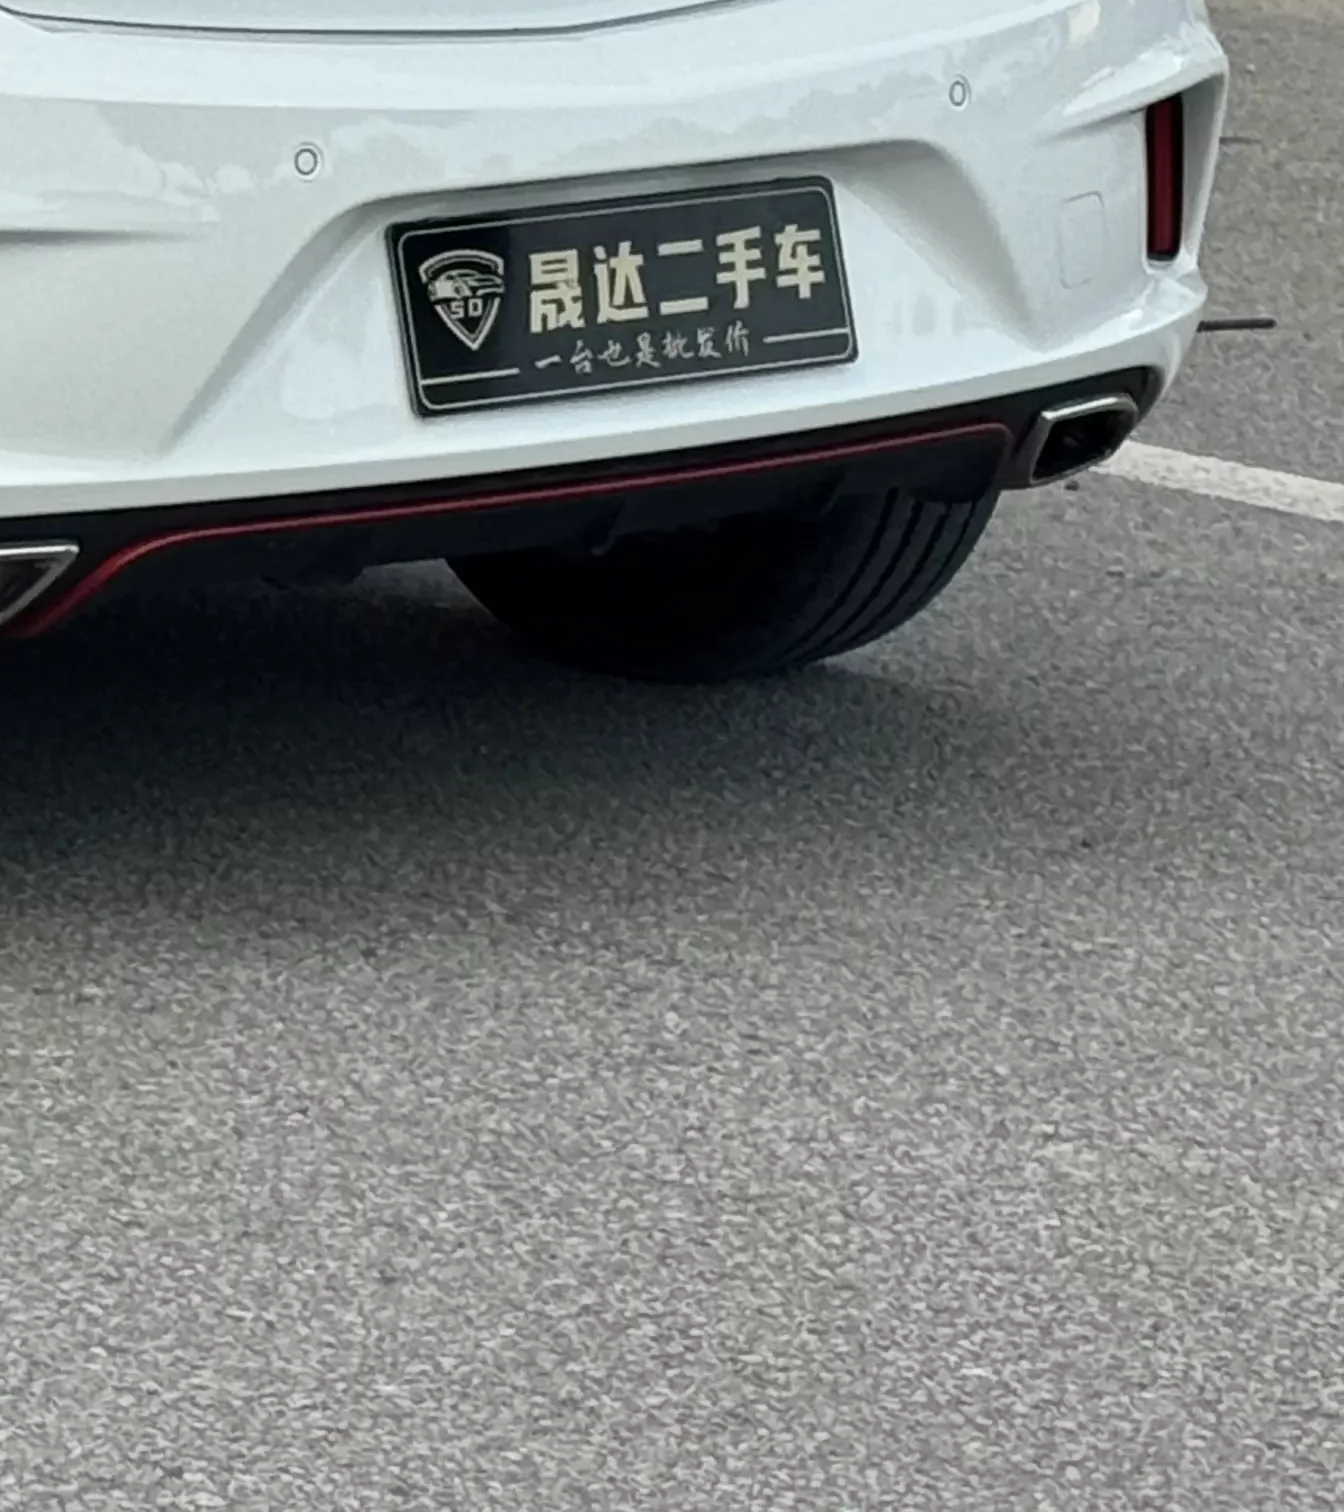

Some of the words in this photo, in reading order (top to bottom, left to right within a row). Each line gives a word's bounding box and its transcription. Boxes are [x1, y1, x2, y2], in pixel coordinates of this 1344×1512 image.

[528, 223, 827, 334] 晟达二手车
[534, 319, 750, 375] 一台也是批发价
